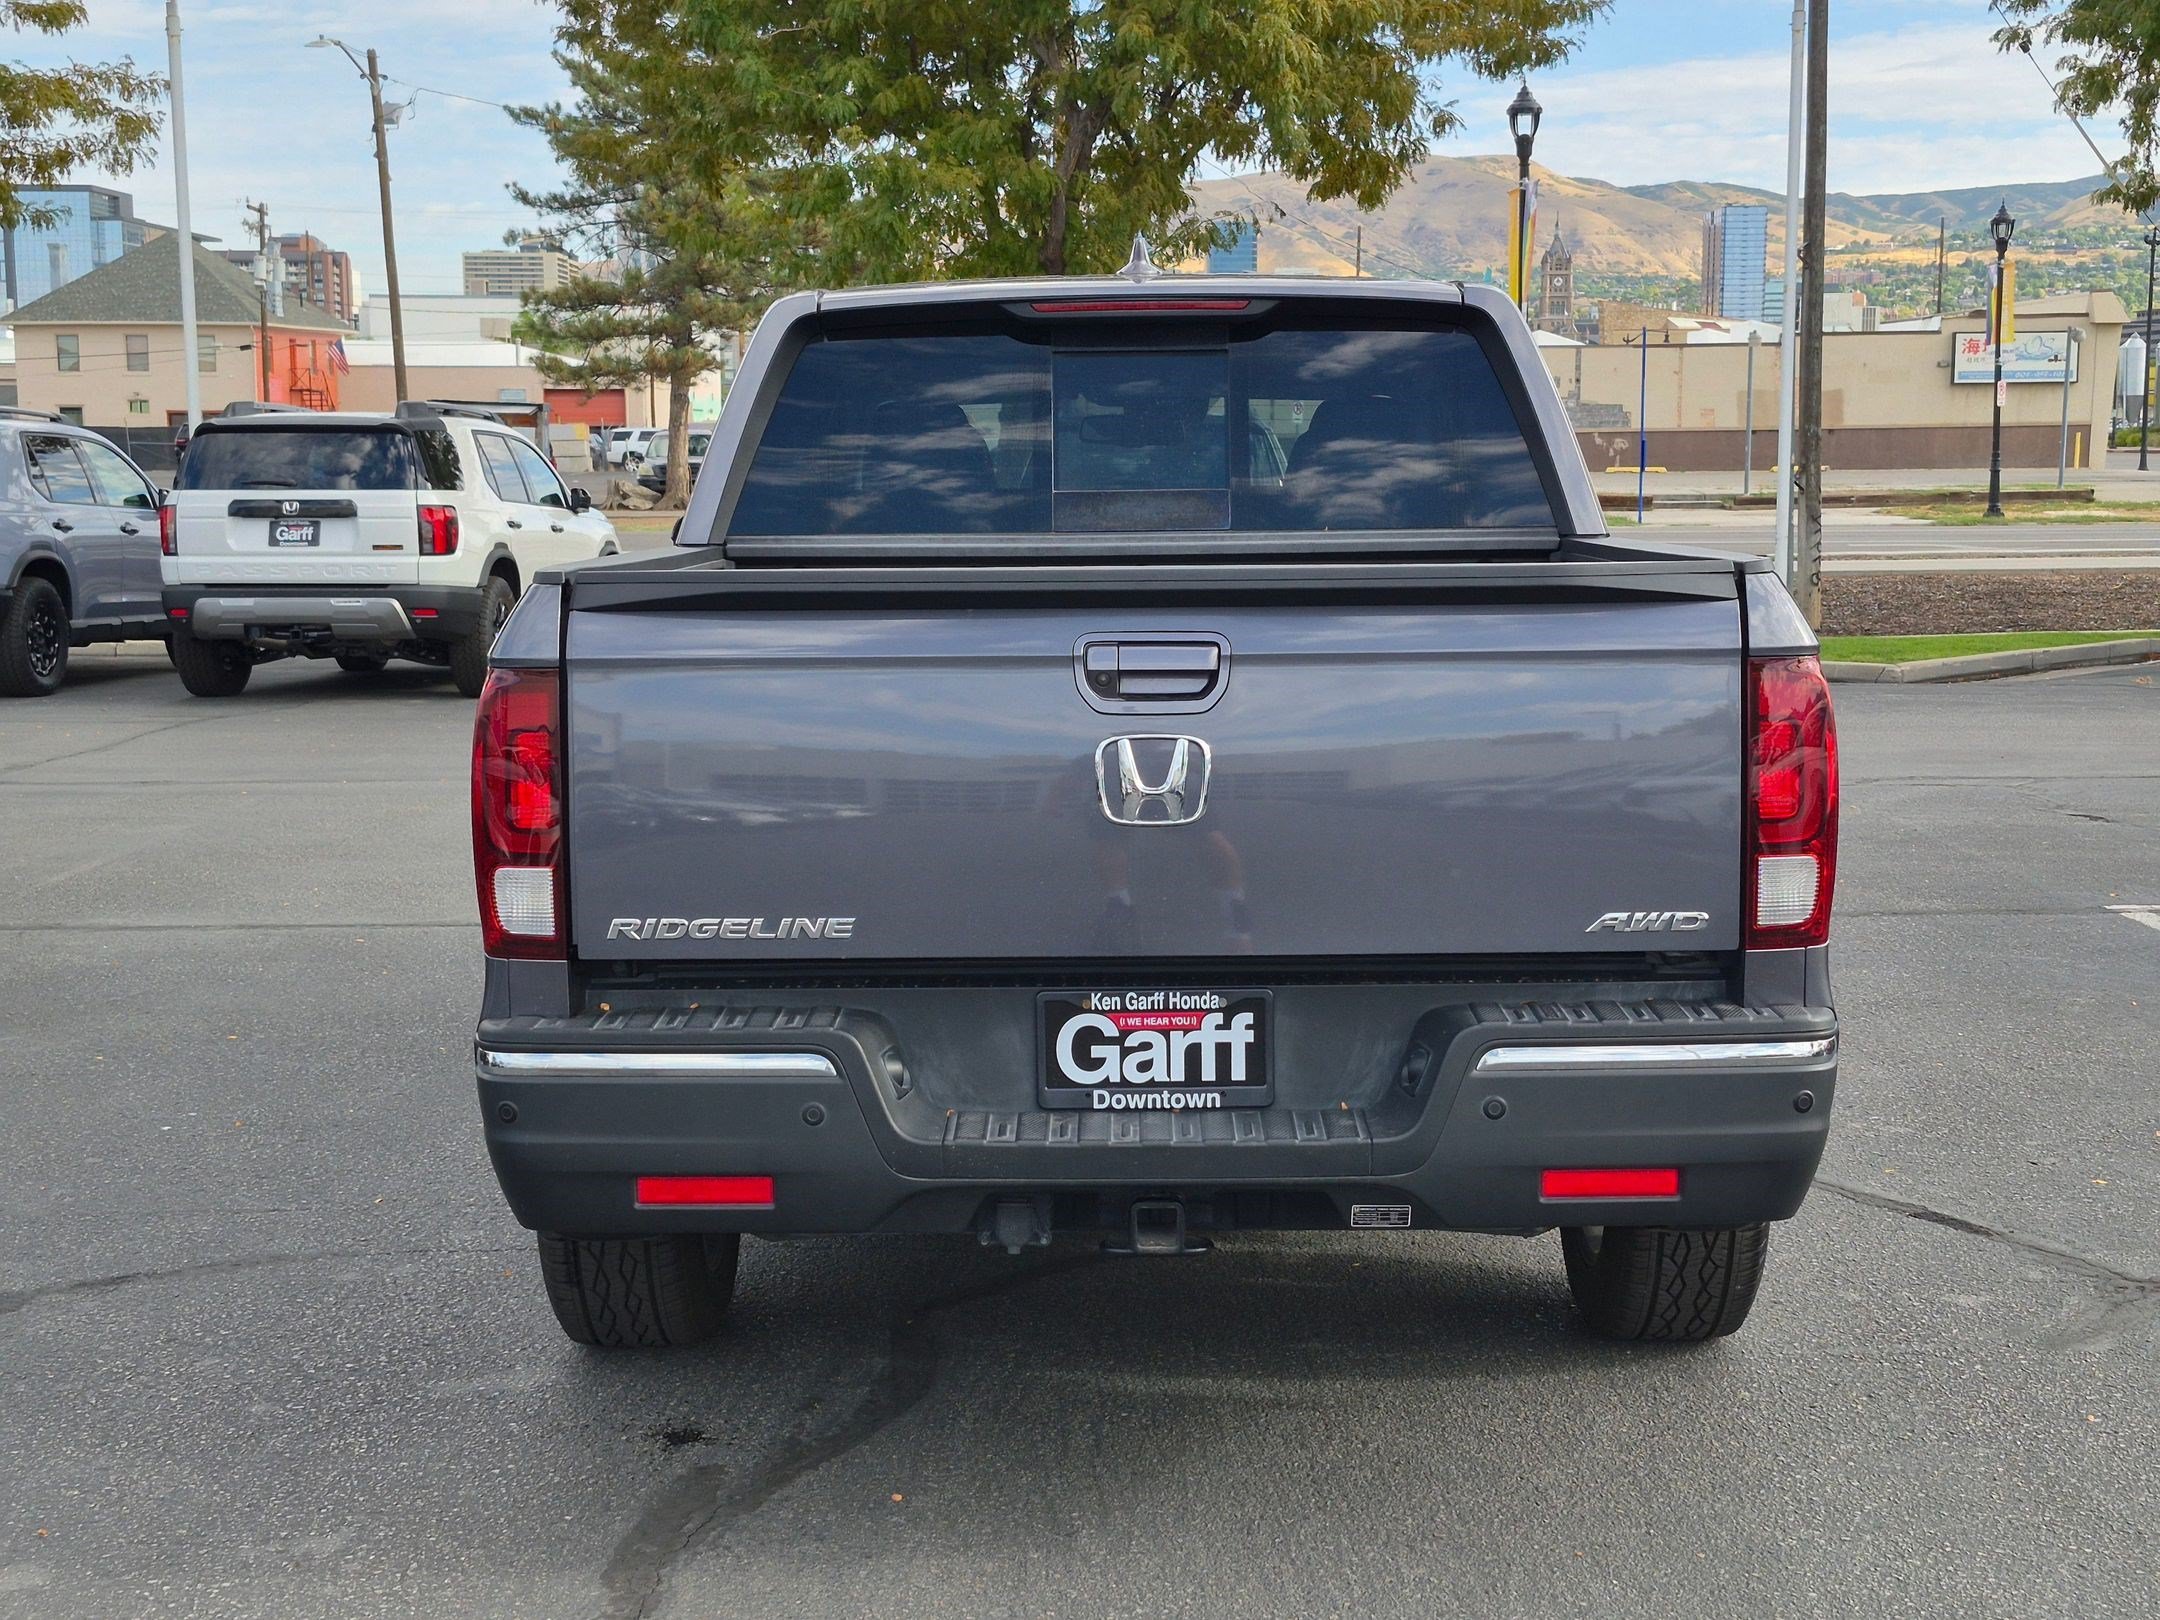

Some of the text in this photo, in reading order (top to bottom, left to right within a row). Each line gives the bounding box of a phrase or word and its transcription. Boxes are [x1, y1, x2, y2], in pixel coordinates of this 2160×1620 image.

[276, 526, 313, 541] Garff
[195, 564, 397, 577] PASSPORT
[606, 917, 857, 940] RIDGELINE
[1584, 911, 1710, 932] AWD
[1090, 991, 1220, 1010] Ken Garff Honda
[1127, 1016, 1190, 1026] WE HEAR YOU
[1055, 1012, 1255, 1085] Garff
[1092, 1089, 1221, 1110] Downtown
